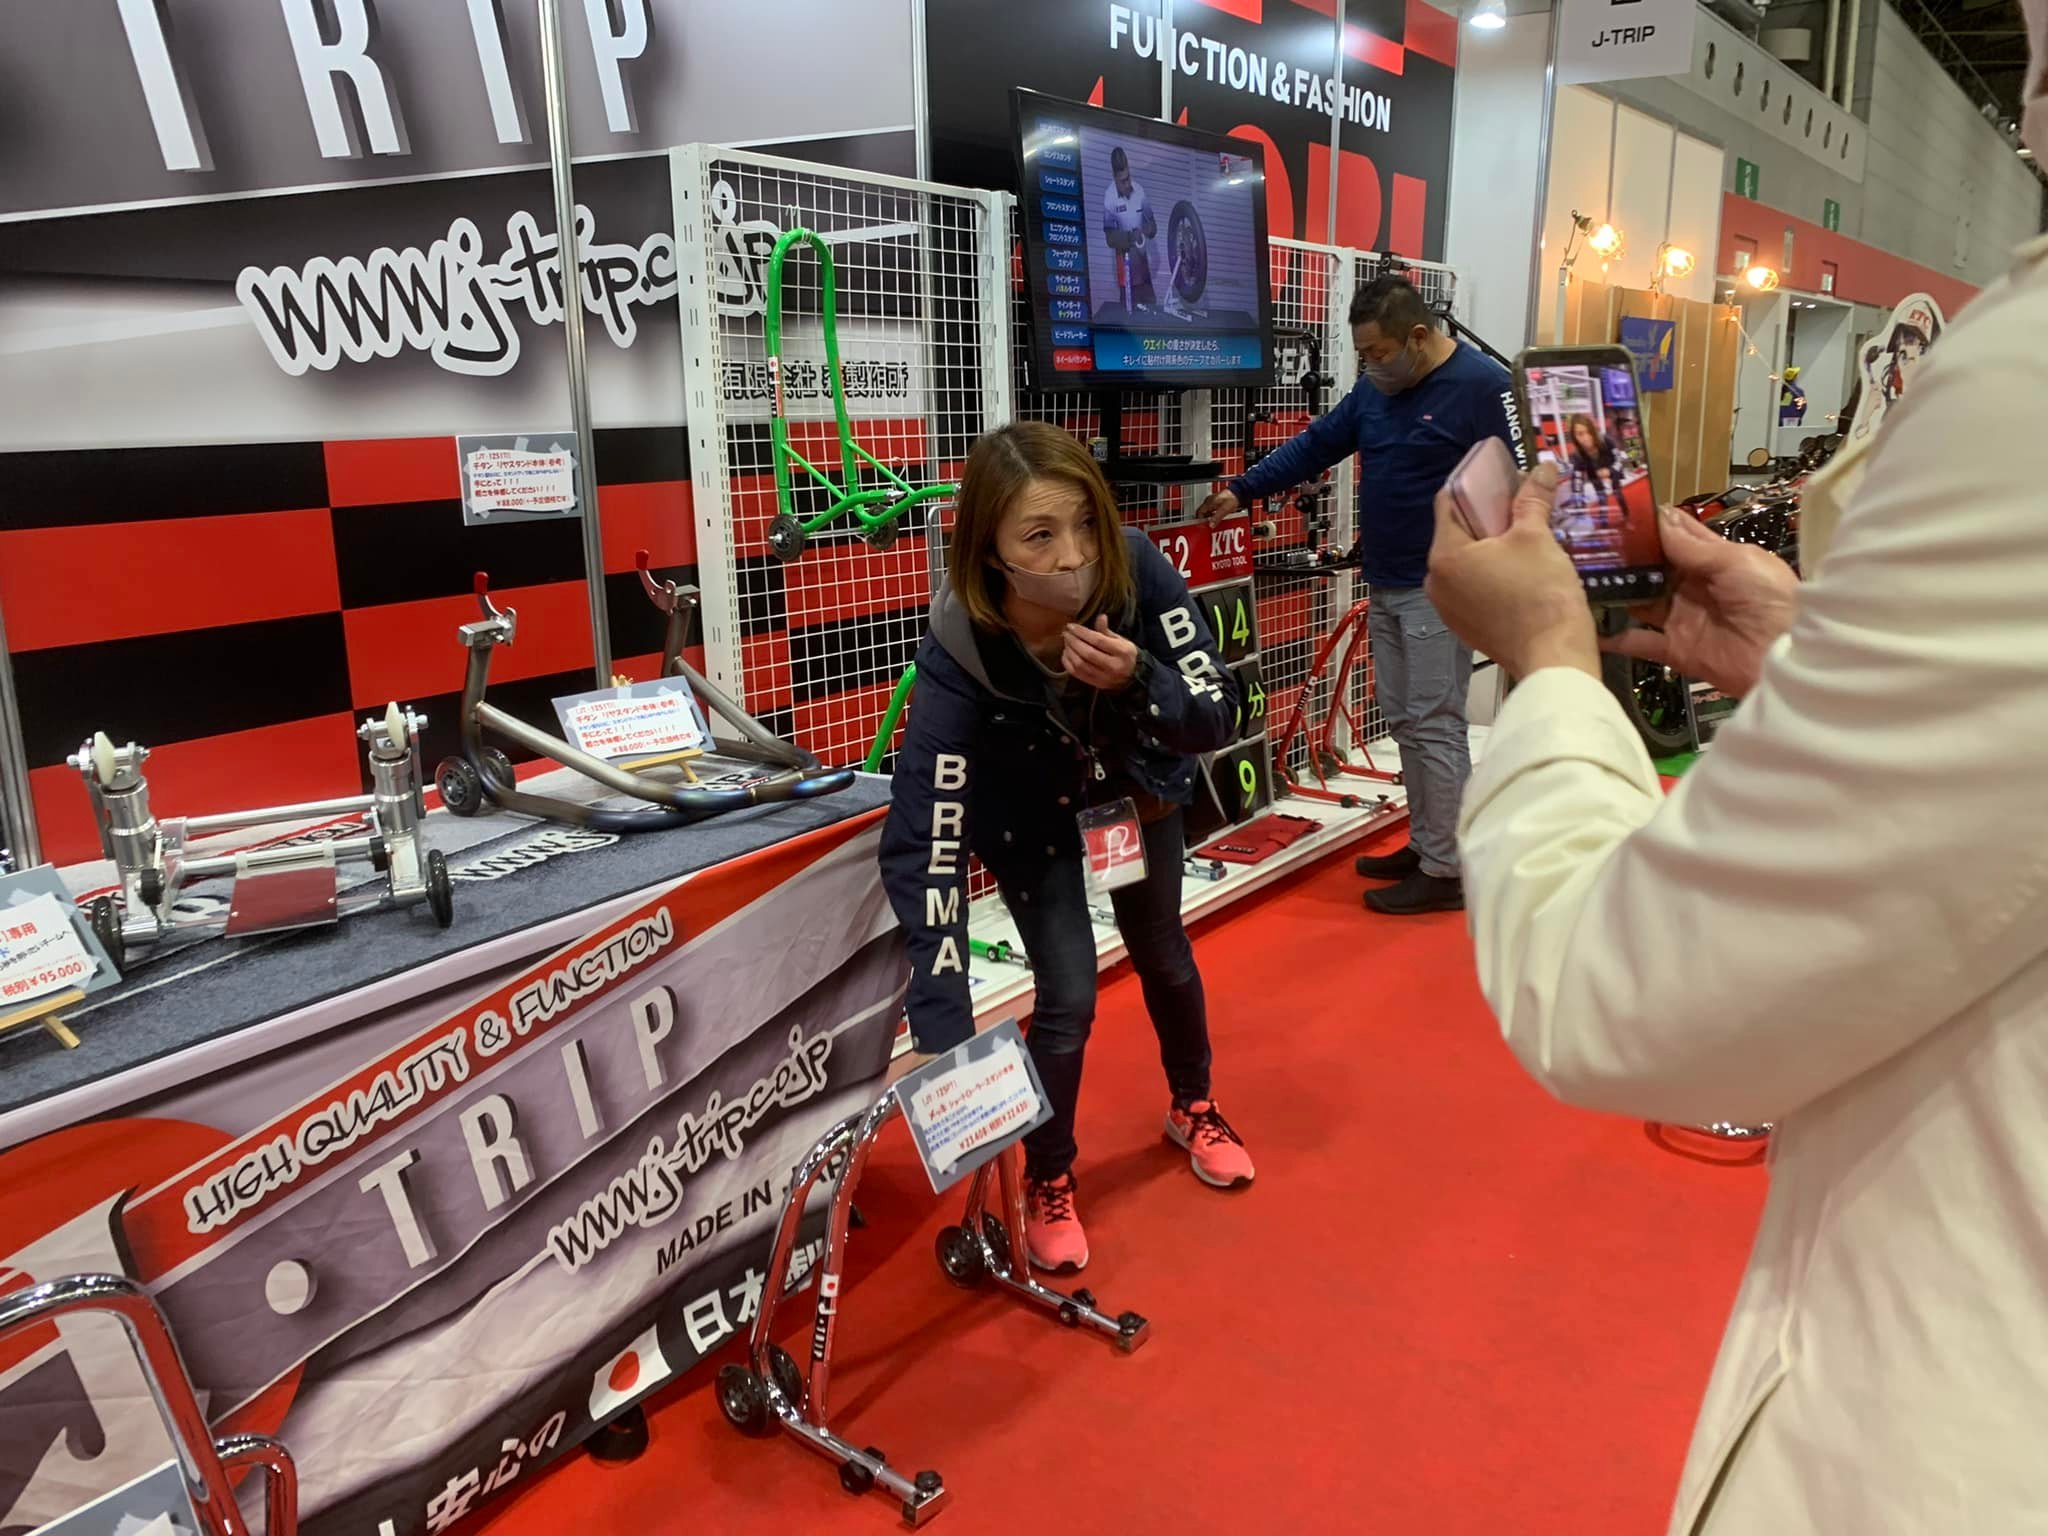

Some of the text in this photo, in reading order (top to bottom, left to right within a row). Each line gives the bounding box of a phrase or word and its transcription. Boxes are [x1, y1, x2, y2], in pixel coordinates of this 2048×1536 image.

[1592, 25, 1656, 47] J-TRIP
[1500, 391, 1522, 441] HANG
[1210, 527, 1246, 558] KTC
[1232, 555, 1247, 566] TOOL
[1239, 759, 1256, 809] 9
[926, 753, 968, 977] BREMA
[189, 910, 673, 1228] HIGH QUALITY & FUNCTION
[656, 1180, 773, 1275] MADE IN
